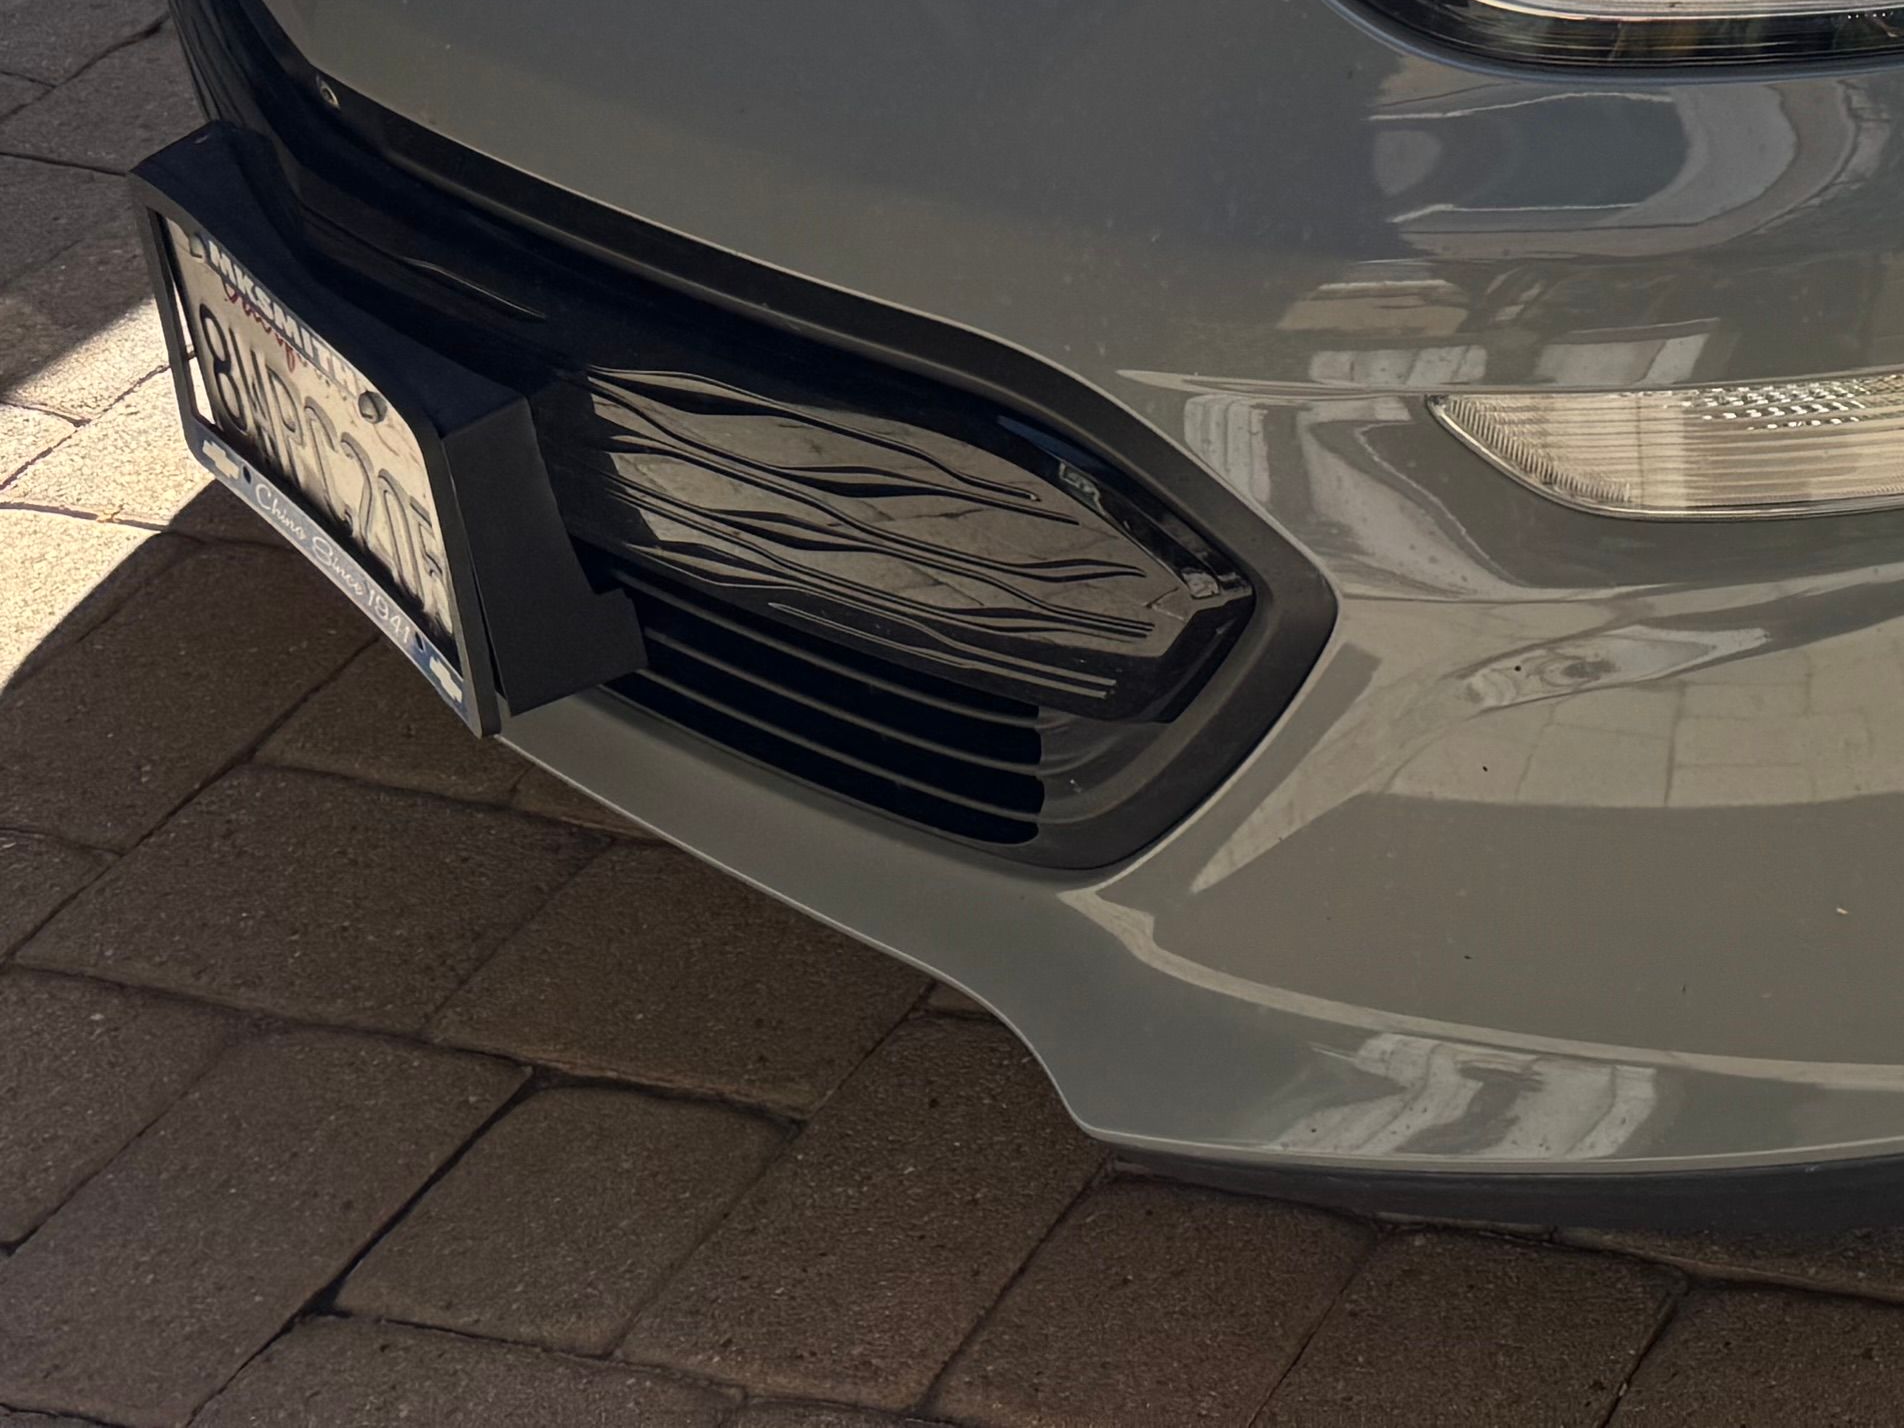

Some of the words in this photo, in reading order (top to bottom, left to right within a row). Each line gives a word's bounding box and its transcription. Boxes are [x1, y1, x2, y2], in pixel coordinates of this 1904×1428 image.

[200, 303, 450, 634] 8WPC205
[255, 483, 306, 541] Chino
[312, 535, 366, 596] Since
[366, 588, 411, 644] 1941
